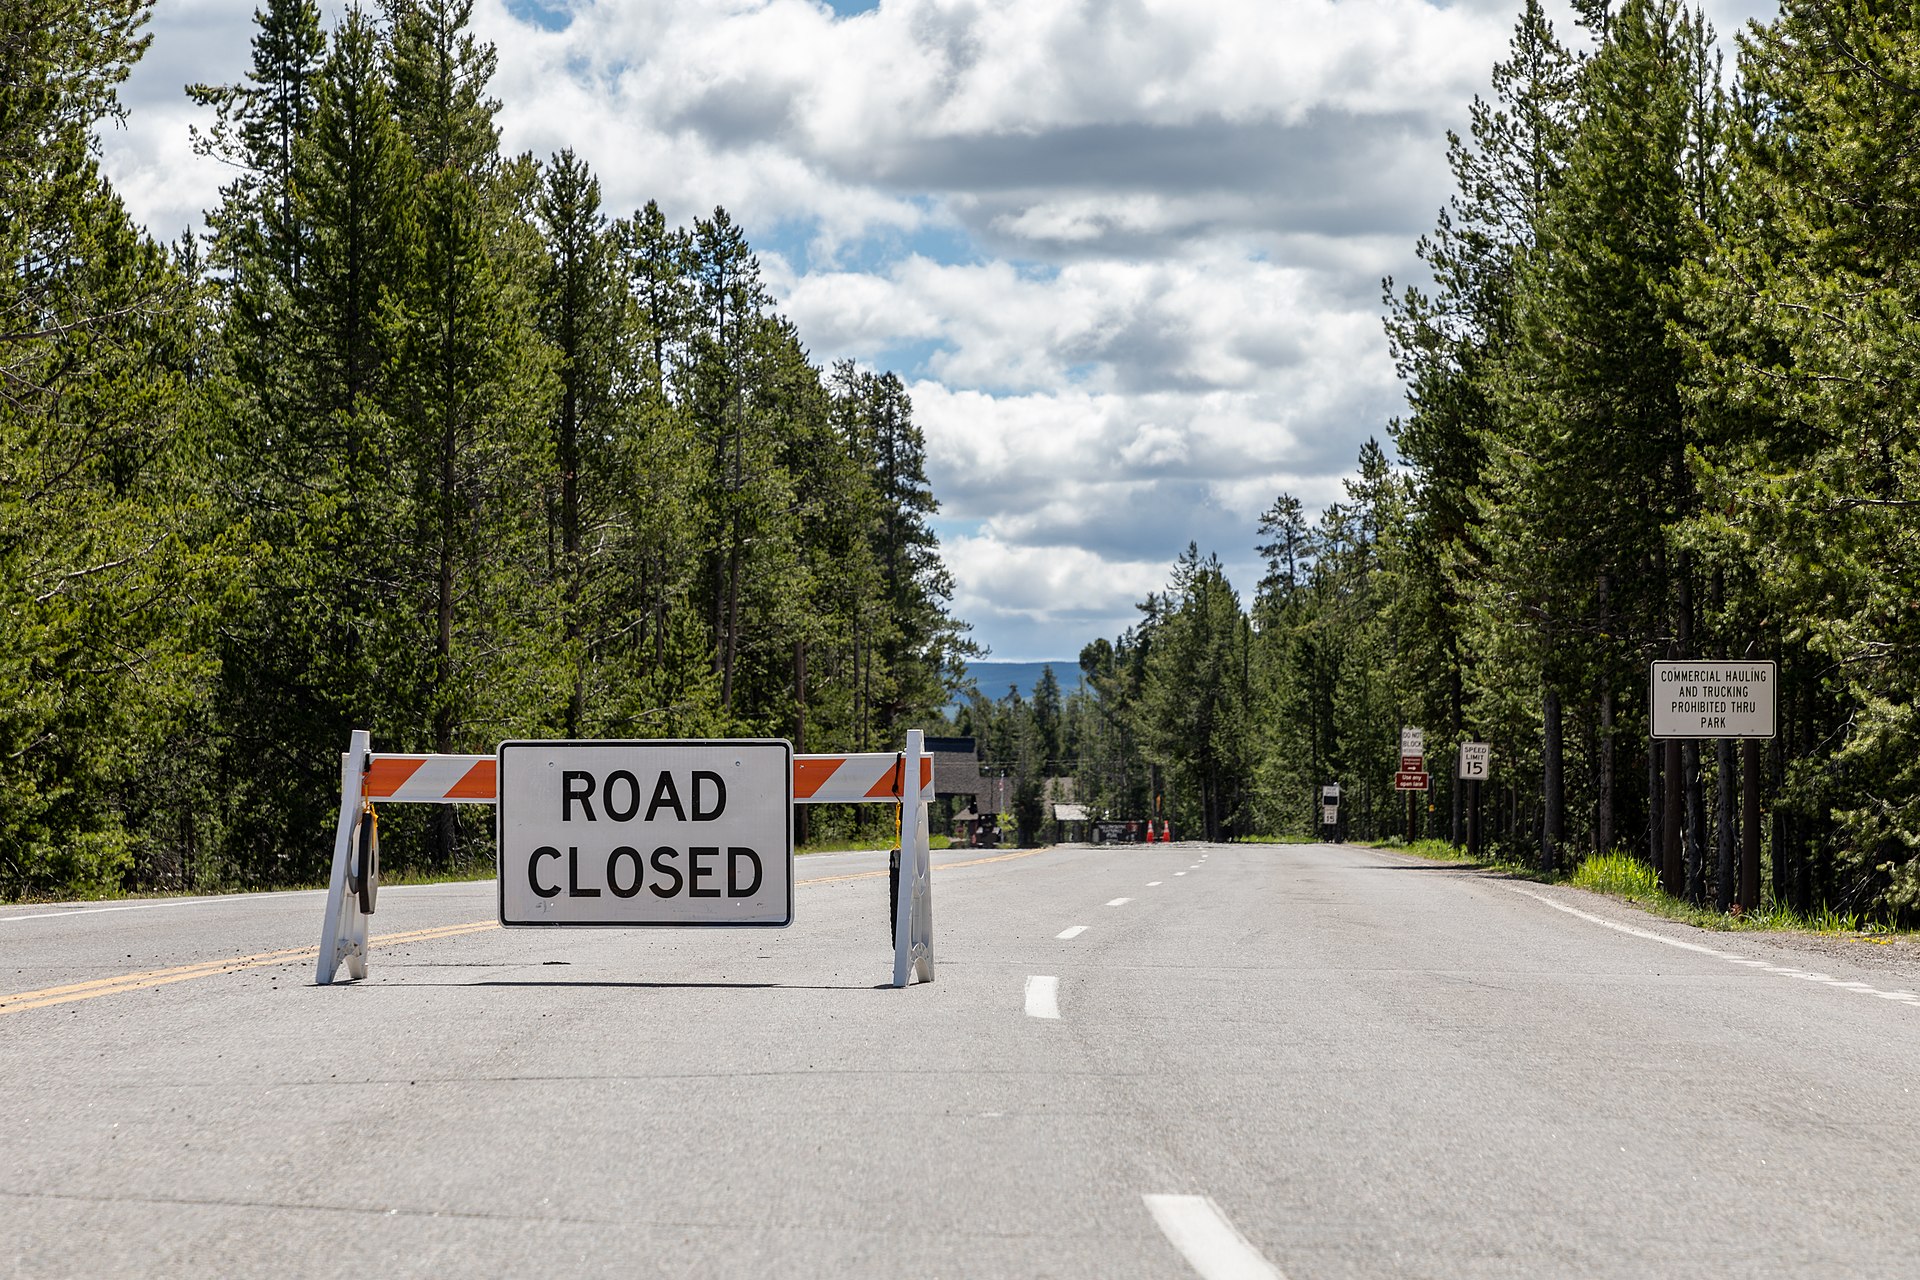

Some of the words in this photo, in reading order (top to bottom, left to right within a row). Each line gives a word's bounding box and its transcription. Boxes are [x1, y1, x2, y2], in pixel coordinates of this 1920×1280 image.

[1661, 670, 1721, 682] COMMERCIAL
[1725, 670, 1767, 682] HAULING
[1678, 686, 1698, 698] AND
[1702, 686, 1749, 698] TRUCKING
[1671, 701, 1727, 713] PROHIBITED
[1730, 701, 1756, 713] THRU
[1700, 717, 1726, 729] PARK
[1403, 731, 1411, 739] DO
[1412, 731, 1422, 739] NOT
[1403, 740, 1421, 748] BLOCK
[1464, 746, 1487, 754] SPEED
[1466, 761, 1483, 775] 15
[562, 769, 727, 822] ROAD
[1326, 815, 1335, 823] 15
[527, 846, 763, 898] CLOSED
